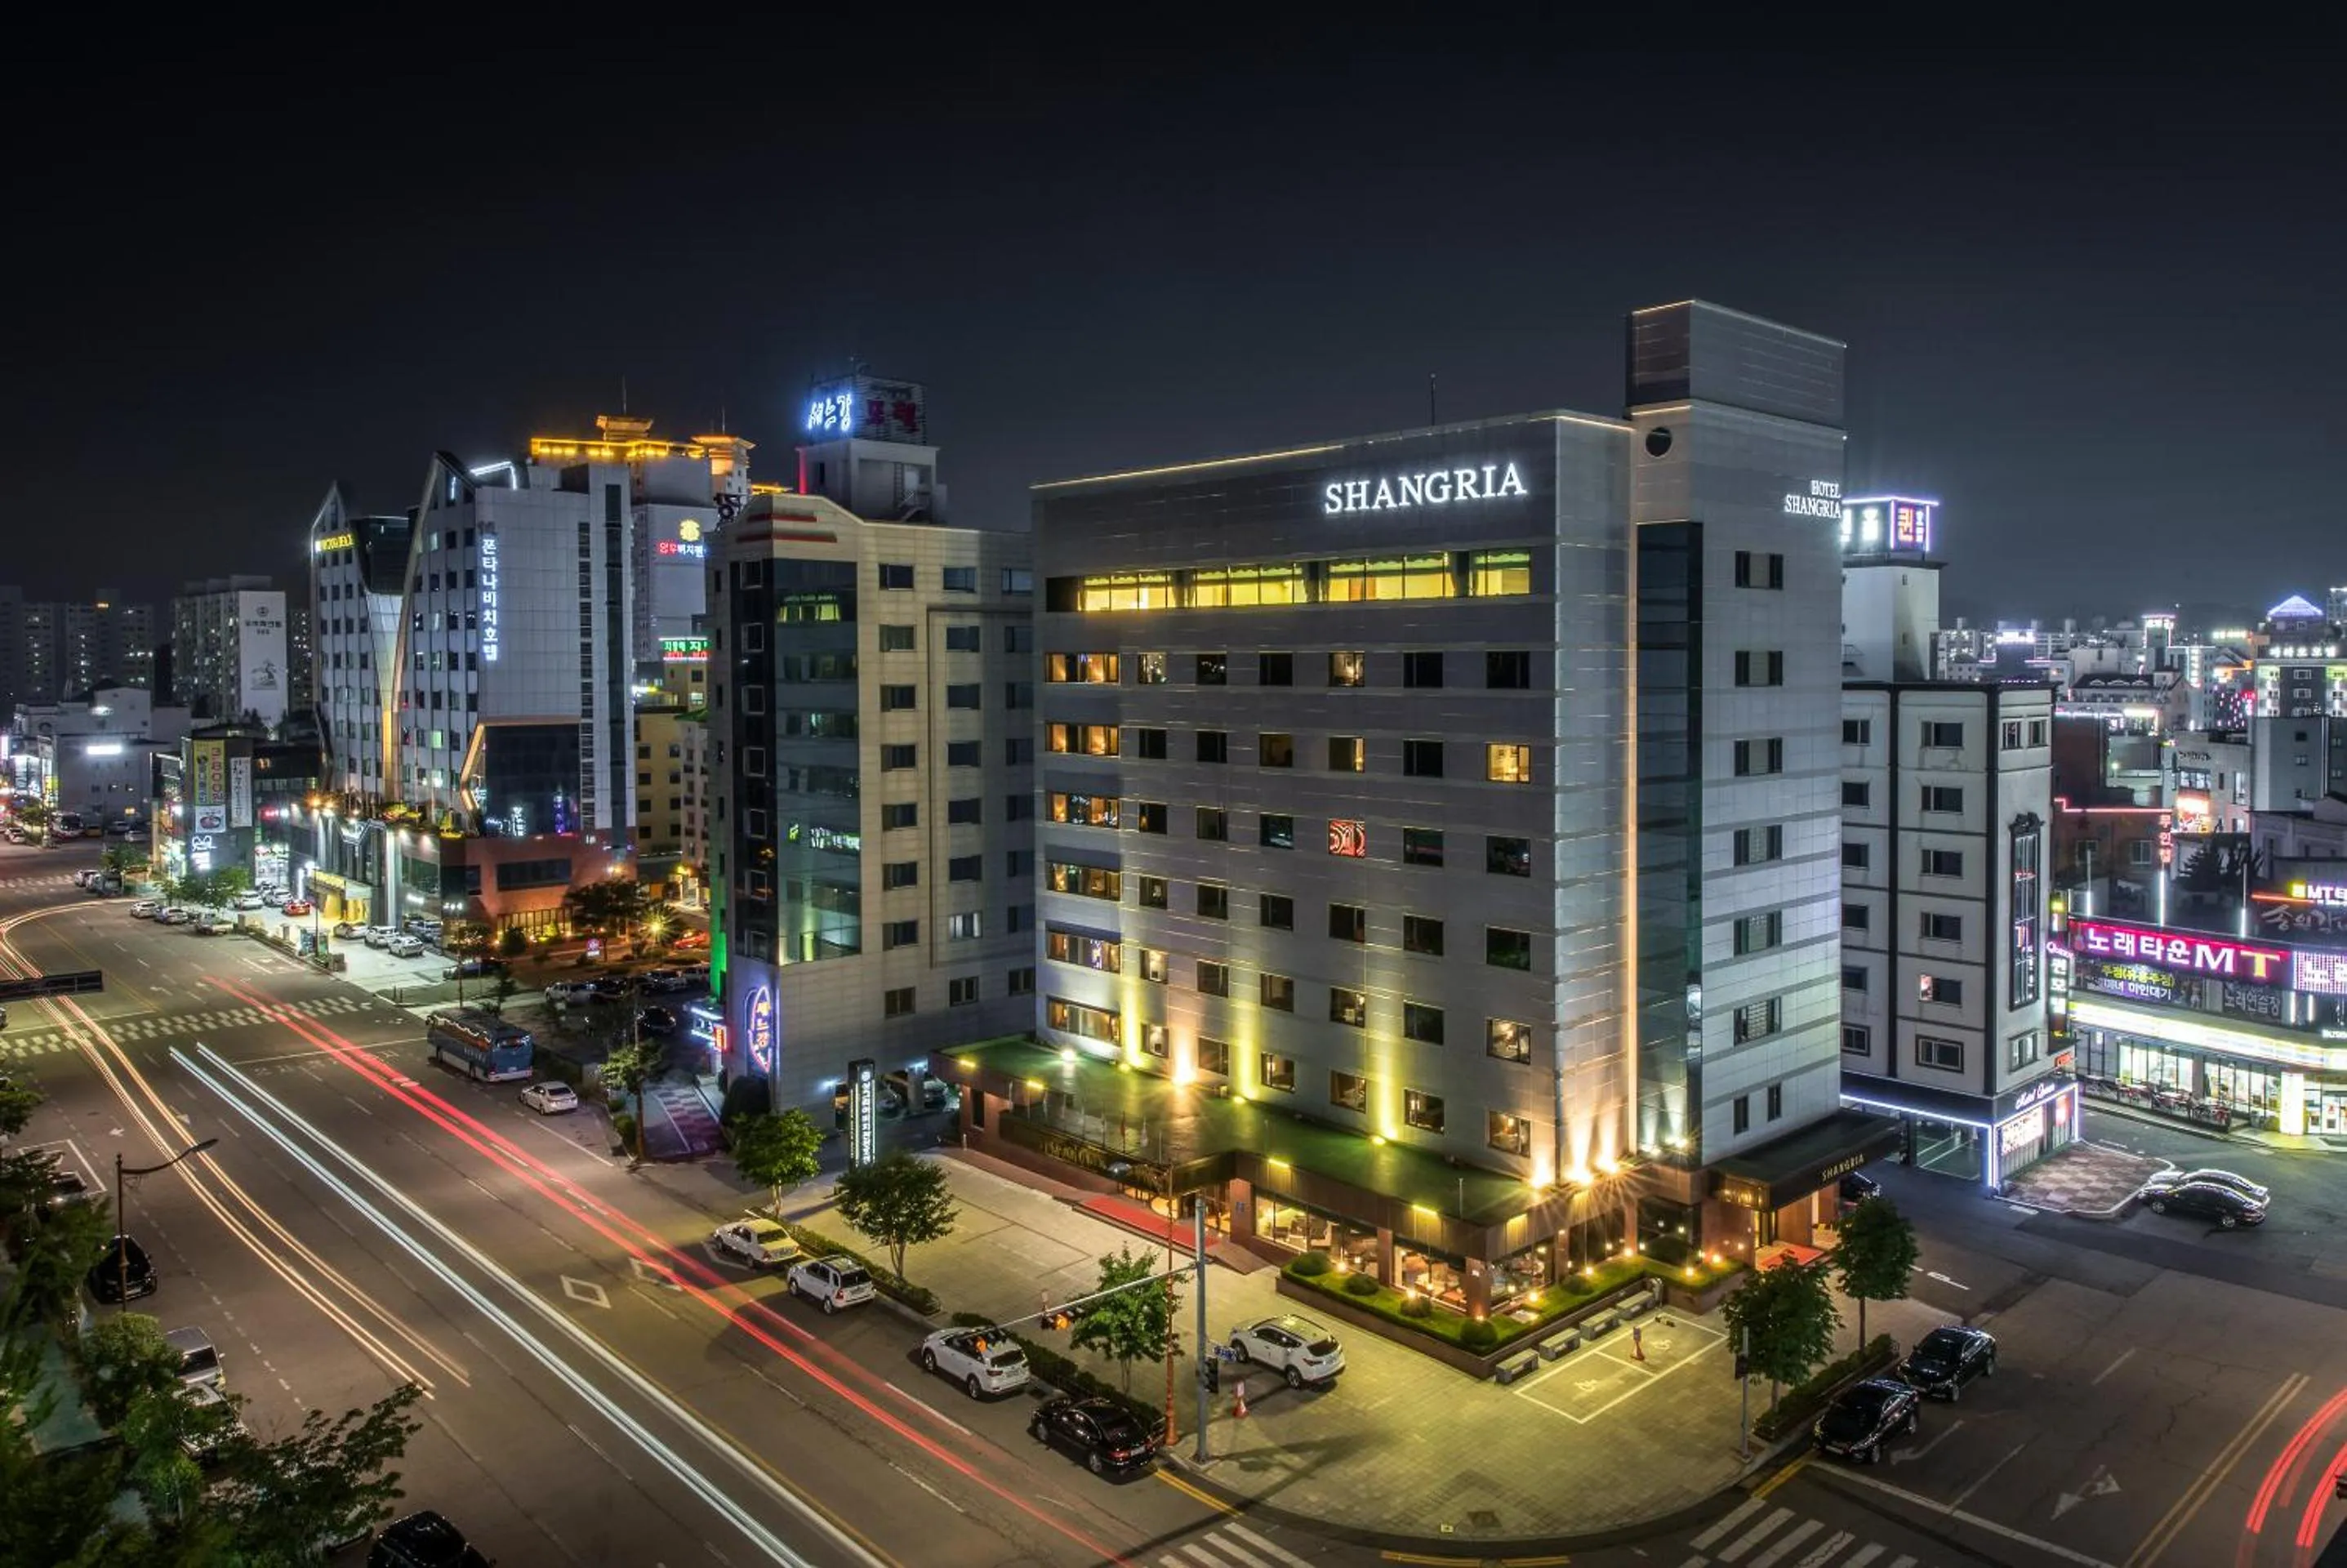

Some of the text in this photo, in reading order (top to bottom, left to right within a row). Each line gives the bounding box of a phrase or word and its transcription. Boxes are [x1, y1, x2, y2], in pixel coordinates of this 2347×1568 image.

[1325, 462, 1528, 514] SHANGRIA
[1810, 480, 1841, 498] HOTEL
[1784, 494, 1842, 519] SHANGRIA
[2225, 987, 2281, 1017] 노래연습장
[1822, 1152, 1865, 1182] SHANGRIA
